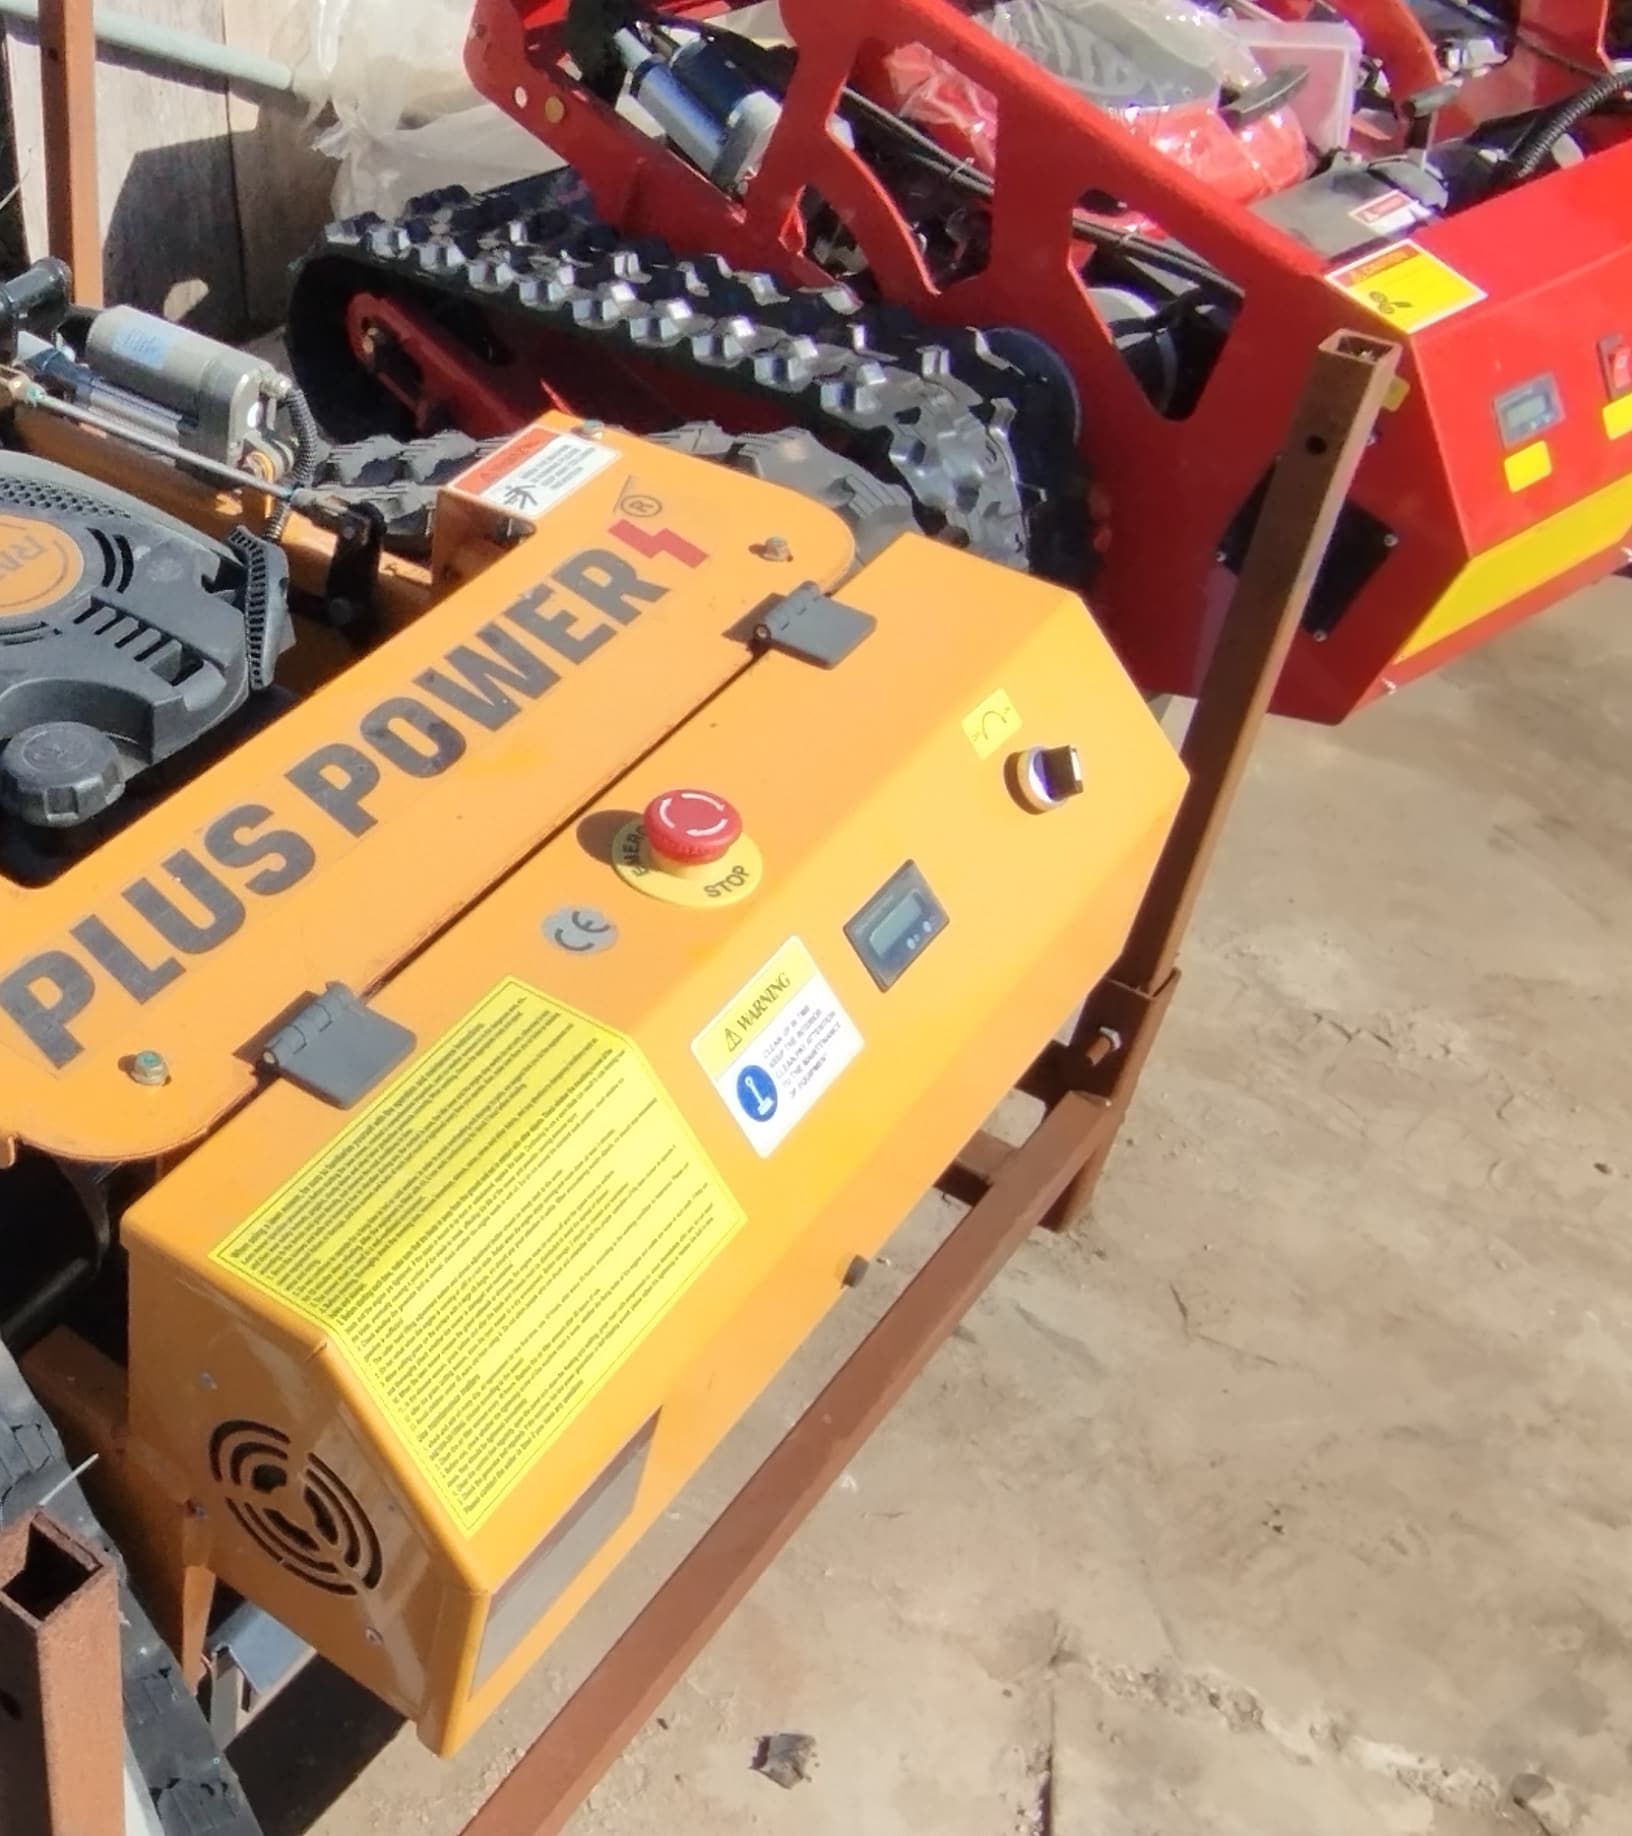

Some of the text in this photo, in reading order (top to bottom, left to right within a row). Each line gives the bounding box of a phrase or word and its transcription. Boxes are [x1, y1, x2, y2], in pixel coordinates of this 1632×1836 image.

[283, 548, 672, 839] POWER
[704, 865, 750, 898] STOP
[554, 911, 611, 951] CE
[736, 972, 791, 1031] WARNING
